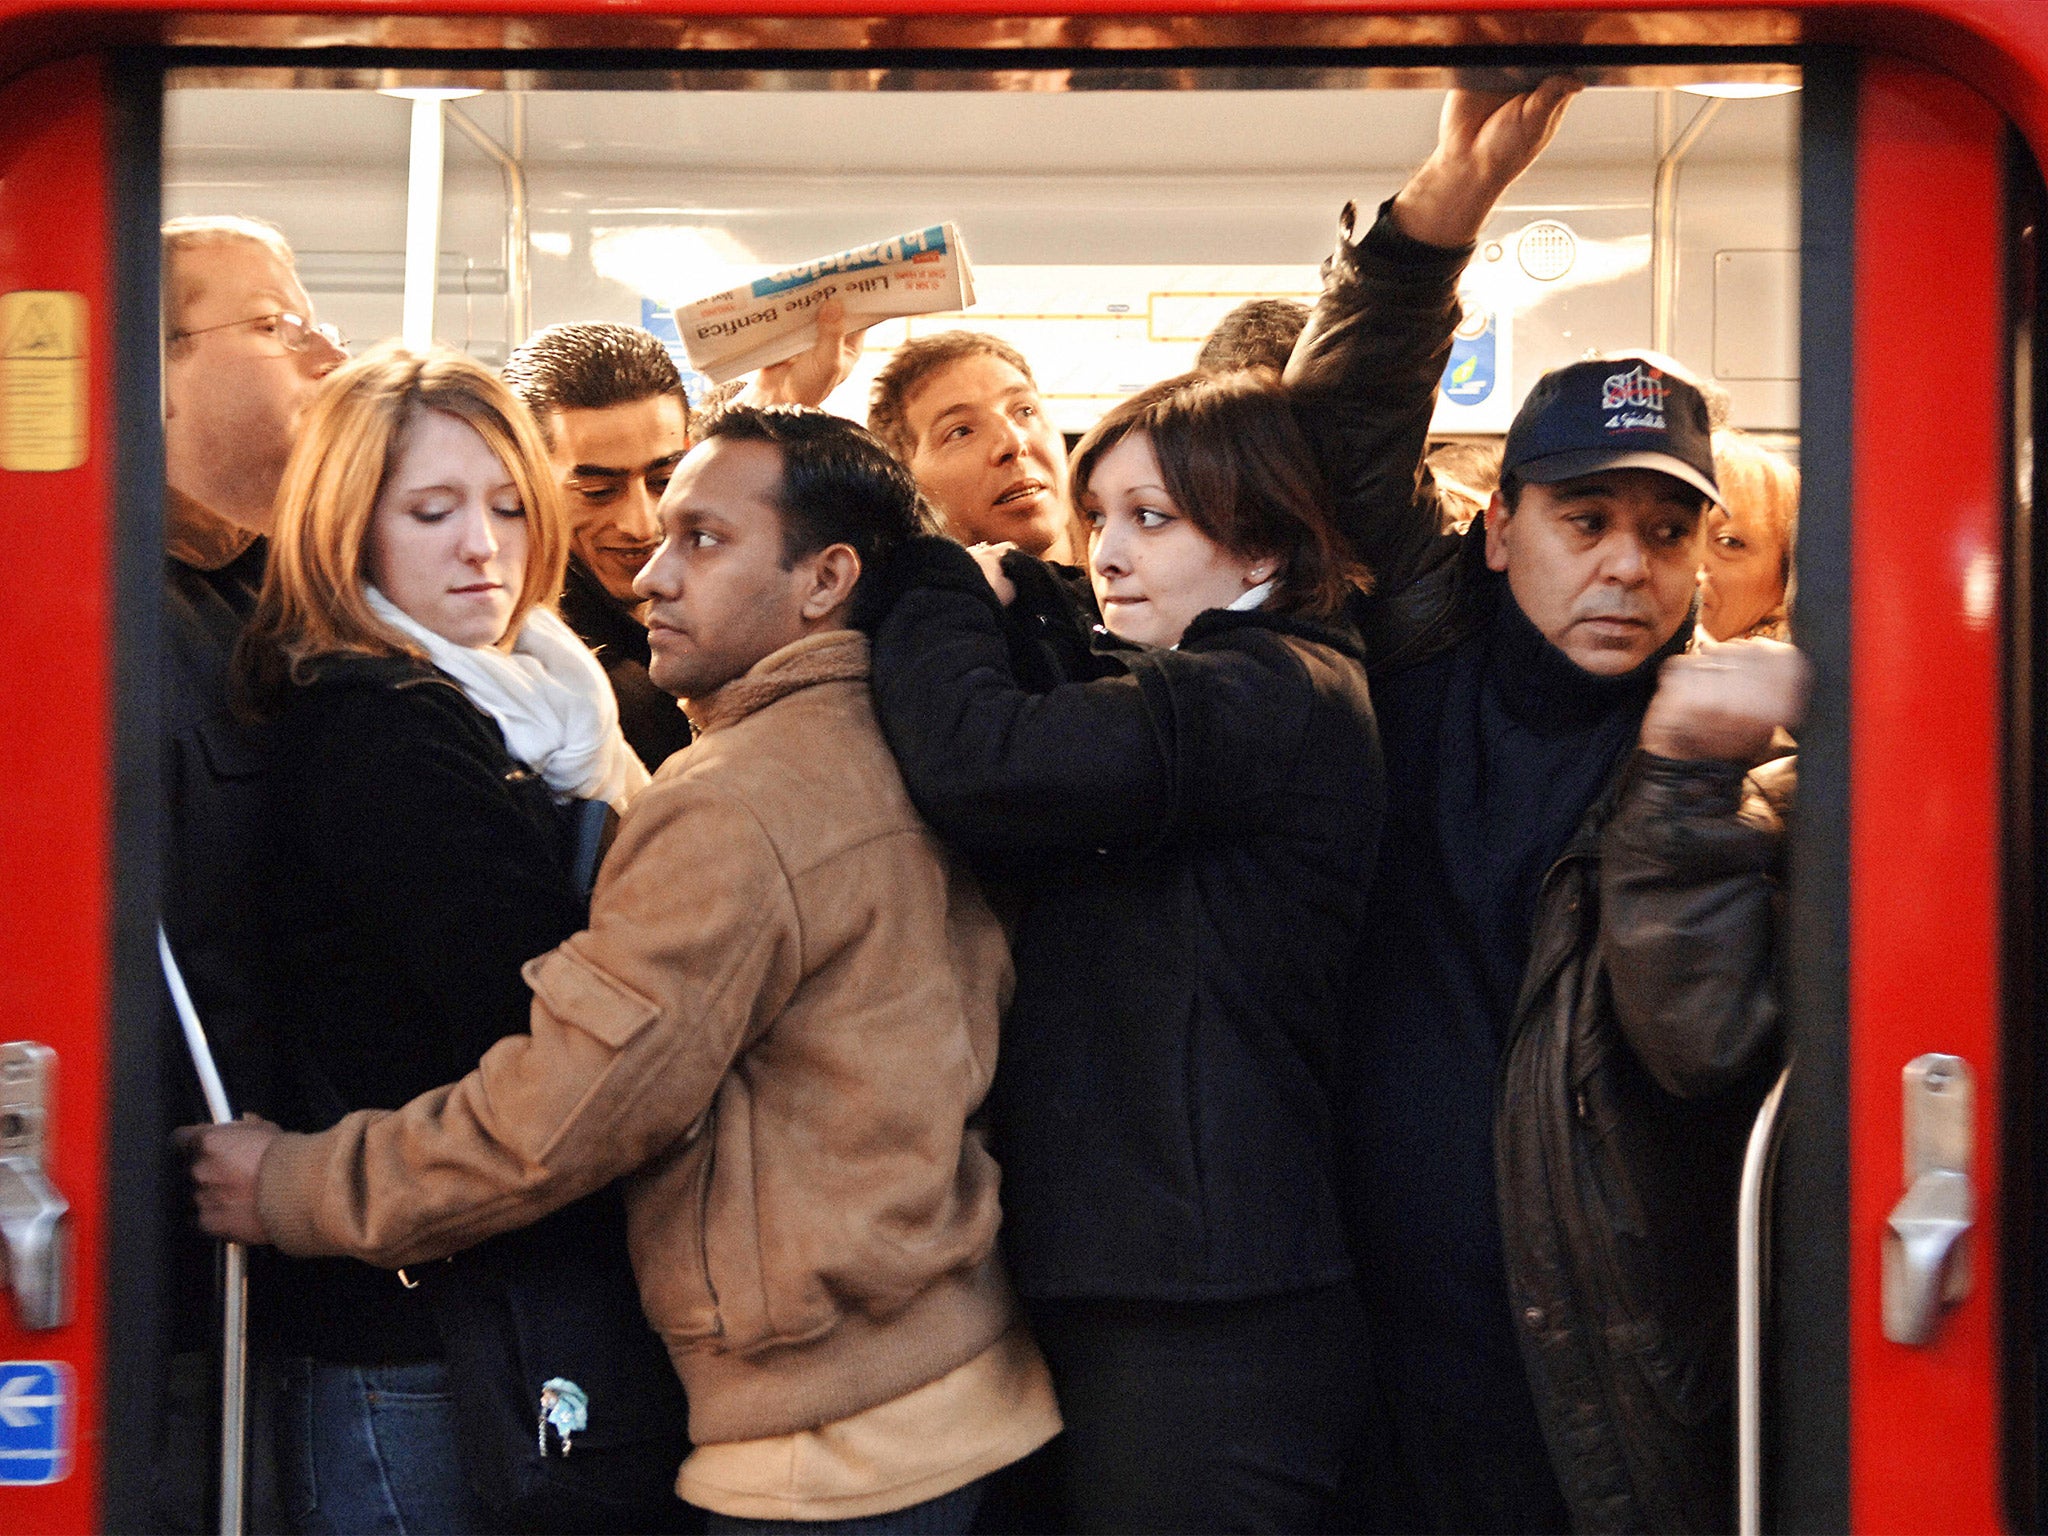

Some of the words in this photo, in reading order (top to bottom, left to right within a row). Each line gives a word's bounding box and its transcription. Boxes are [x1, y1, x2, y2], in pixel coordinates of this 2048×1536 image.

[845, 275, 888, 293] Lille
[785, 286, 837, 312] défie
[697, 308, 778, 339] Benfica
